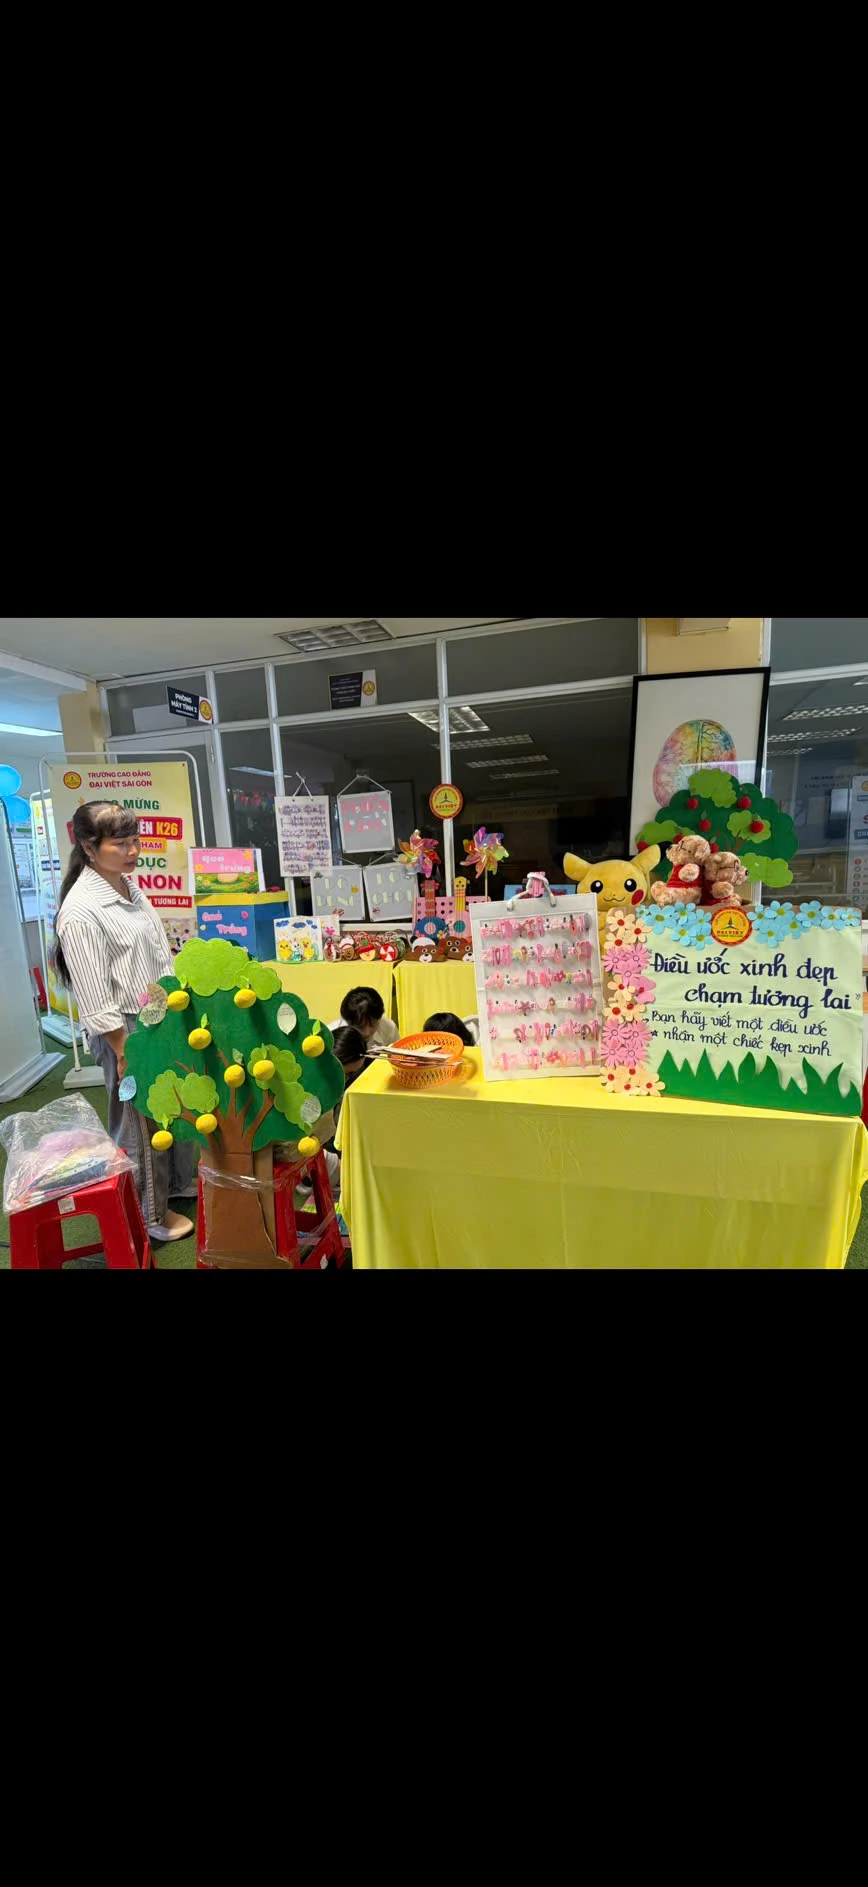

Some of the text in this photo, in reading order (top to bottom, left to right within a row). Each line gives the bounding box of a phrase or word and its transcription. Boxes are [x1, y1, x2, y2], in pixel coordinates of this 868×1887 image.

[171, 700, 182, 708] MÁY
[174, 692, 192, 704] PHÒNG
[124, 797, 160, 810] MỪNG
[156, 821, 178, 836] K26
[138, 874, 182, 890] NON
[740, 952, 788, 978] xinh
[796, 958, 838, 986] đẹp
[684, 983, 742, 1008] chạm
[652, 1010, 676, 1024] Bạn
[680, 1010, 708, 1032] hãy
[711, 1010, 732, 1028] viết
[736, 1017, 764, 1033] một
[767, 1018, 798, 1034] điều
[664, 1026, 832, 1057] nhận một chiếc kẹp xinh
